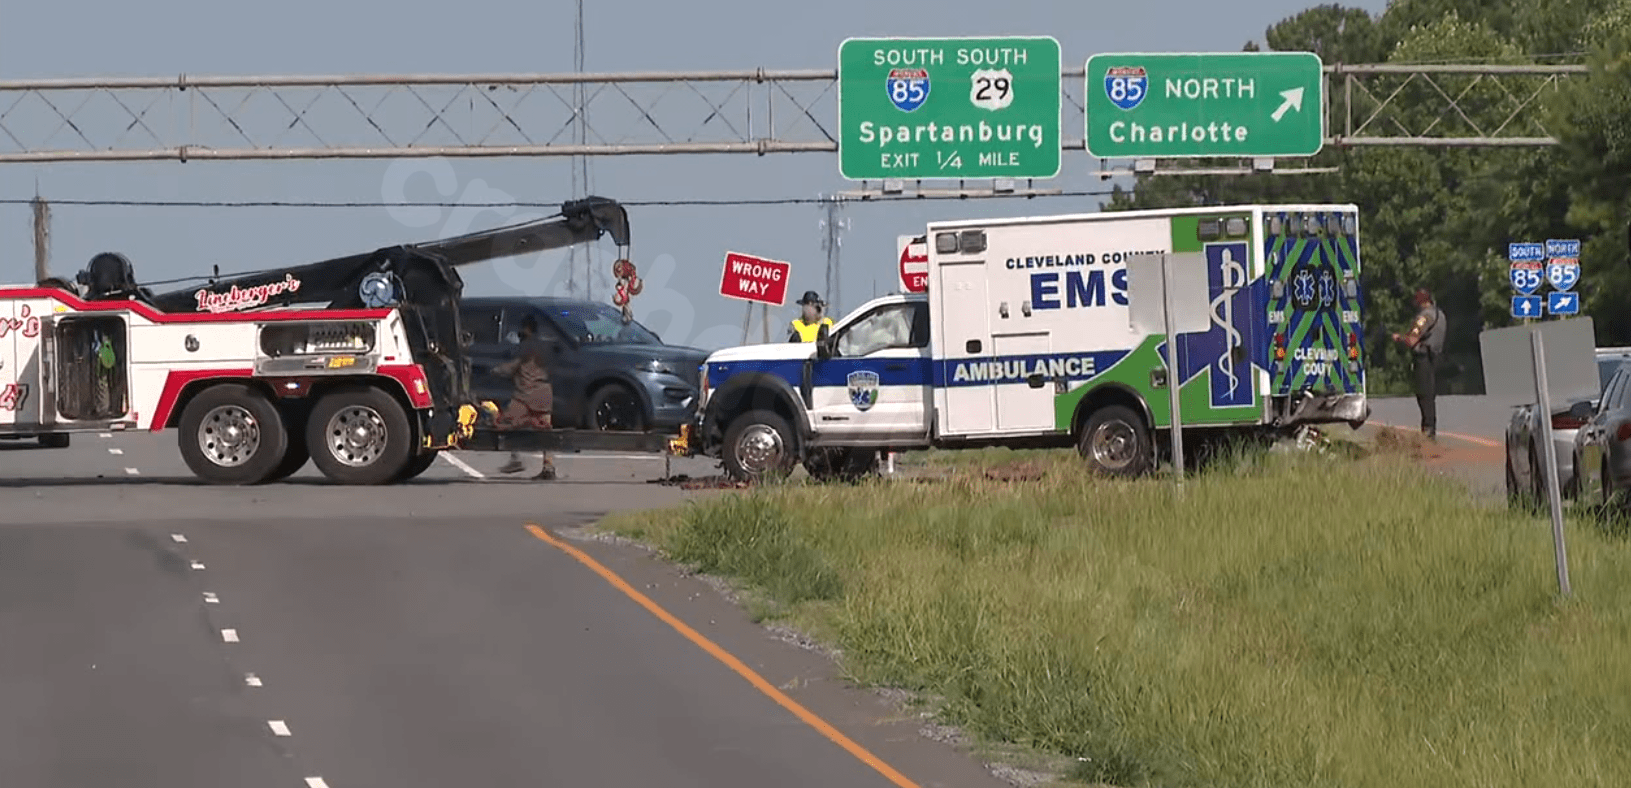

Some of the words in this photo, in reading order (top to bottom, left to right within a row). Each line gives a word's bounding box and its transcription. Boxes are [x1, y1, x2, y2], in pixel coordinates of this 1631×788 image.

[874, 48, 944, 65] SOUTH
[957, 48, 1028, 65] SOUTH
[891, 80, 924, 103] 85
[975, 77, 1010, 101] 29
[1110, 78, 1142, 101] 85
[1165, 78, 1255, 99] NORTH
[859, 120, 1043, 148] Spartanburg
[1109, 120, 1248, 143] Charlotte
[881, 153, 920, 168] EXIT
[979, 152, 1020, 166] MILE
[732, 260, 782, 282] WRONG
[1005, 254, 1096, 270] CLEVELAND
[1514, 269, 1540, 289] 85
[1551, 265, 1576, 284] 85
[739, 277, 770, 296] WAY
[1030, 268, 1129, 310] EMS
[953, 357, 1096, 382] AMBULANCE
